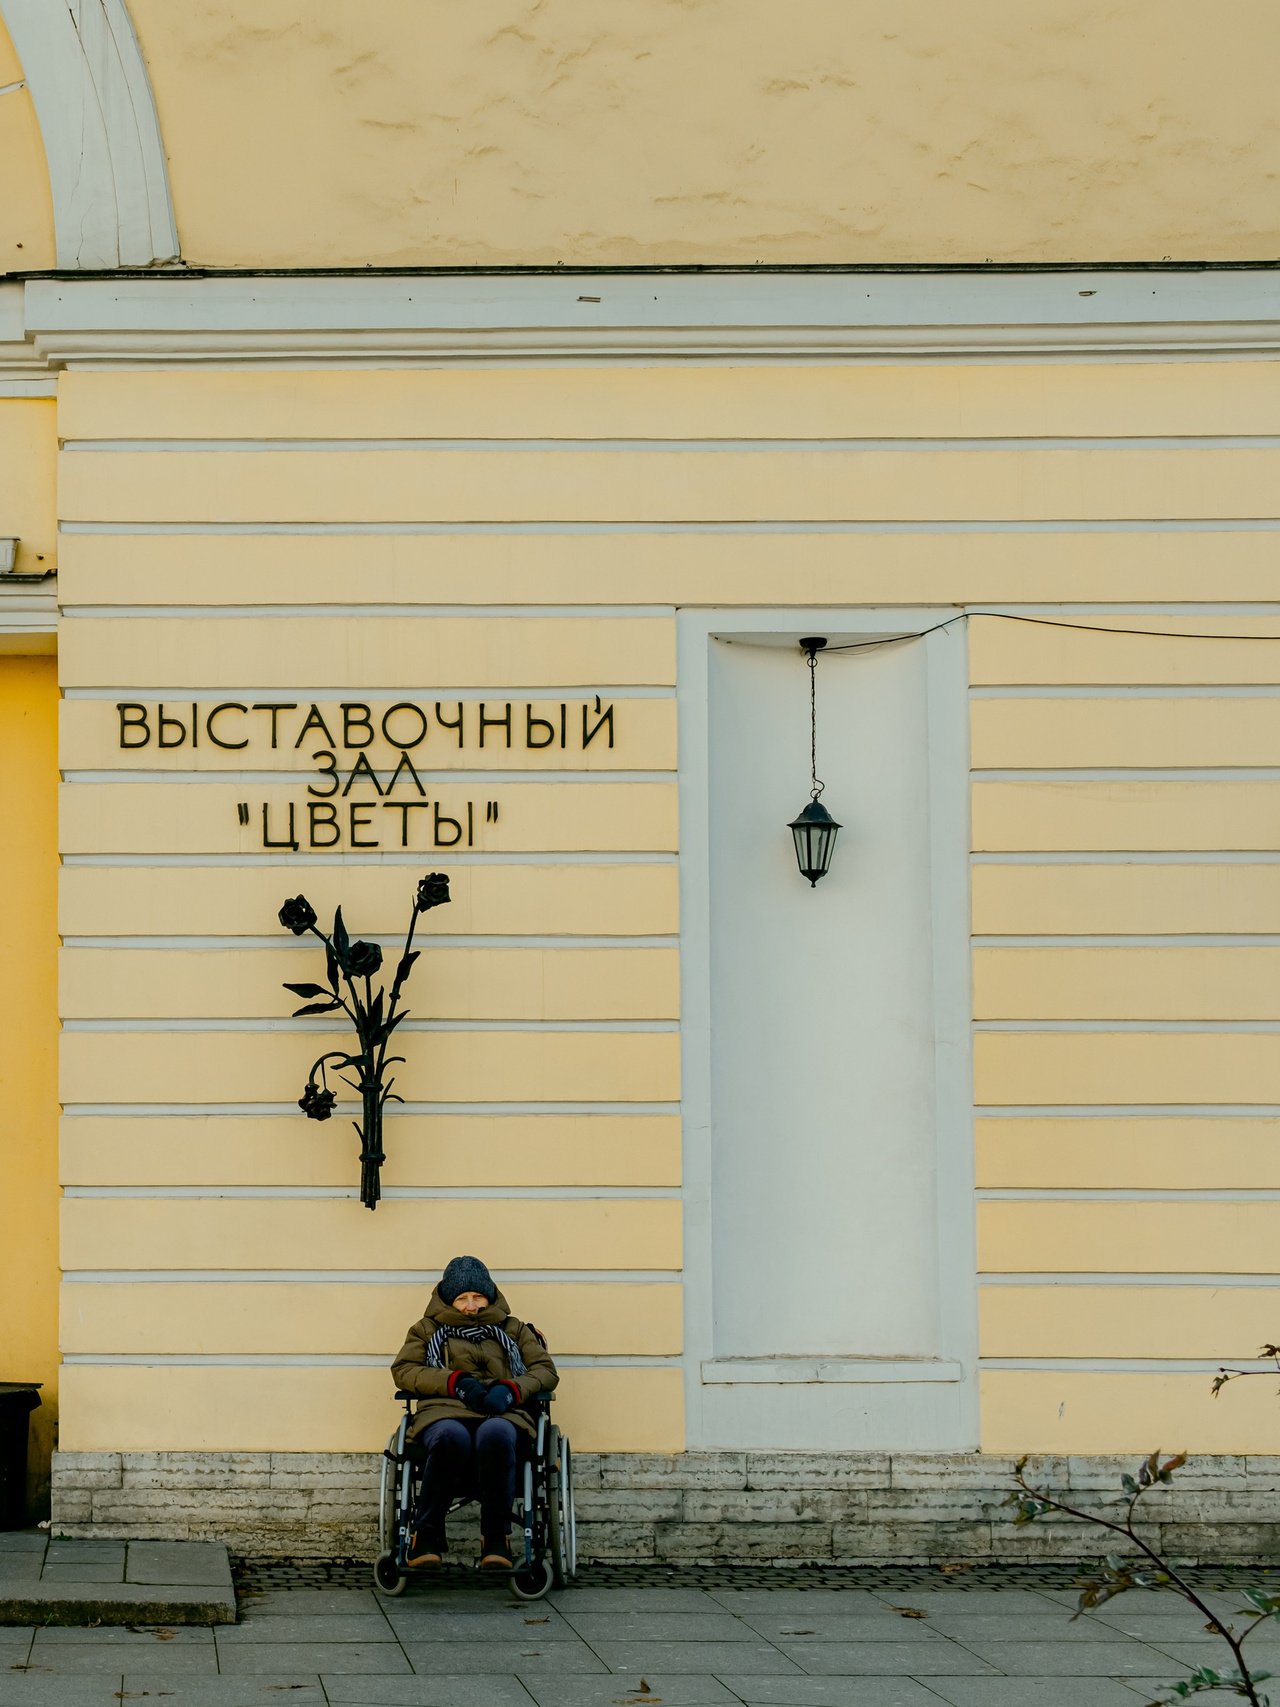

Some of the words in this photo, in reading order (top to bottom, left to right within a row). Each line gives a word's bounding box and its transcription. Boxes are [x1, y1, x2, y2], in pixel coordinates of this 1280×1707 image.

[116, 694, 615, 749] ВЫСТАВОЧНЫЙ
[307, 750, 426, 797] ЗАЛ
[237, 801, 498, 851] "ЦВЕТЫ"
